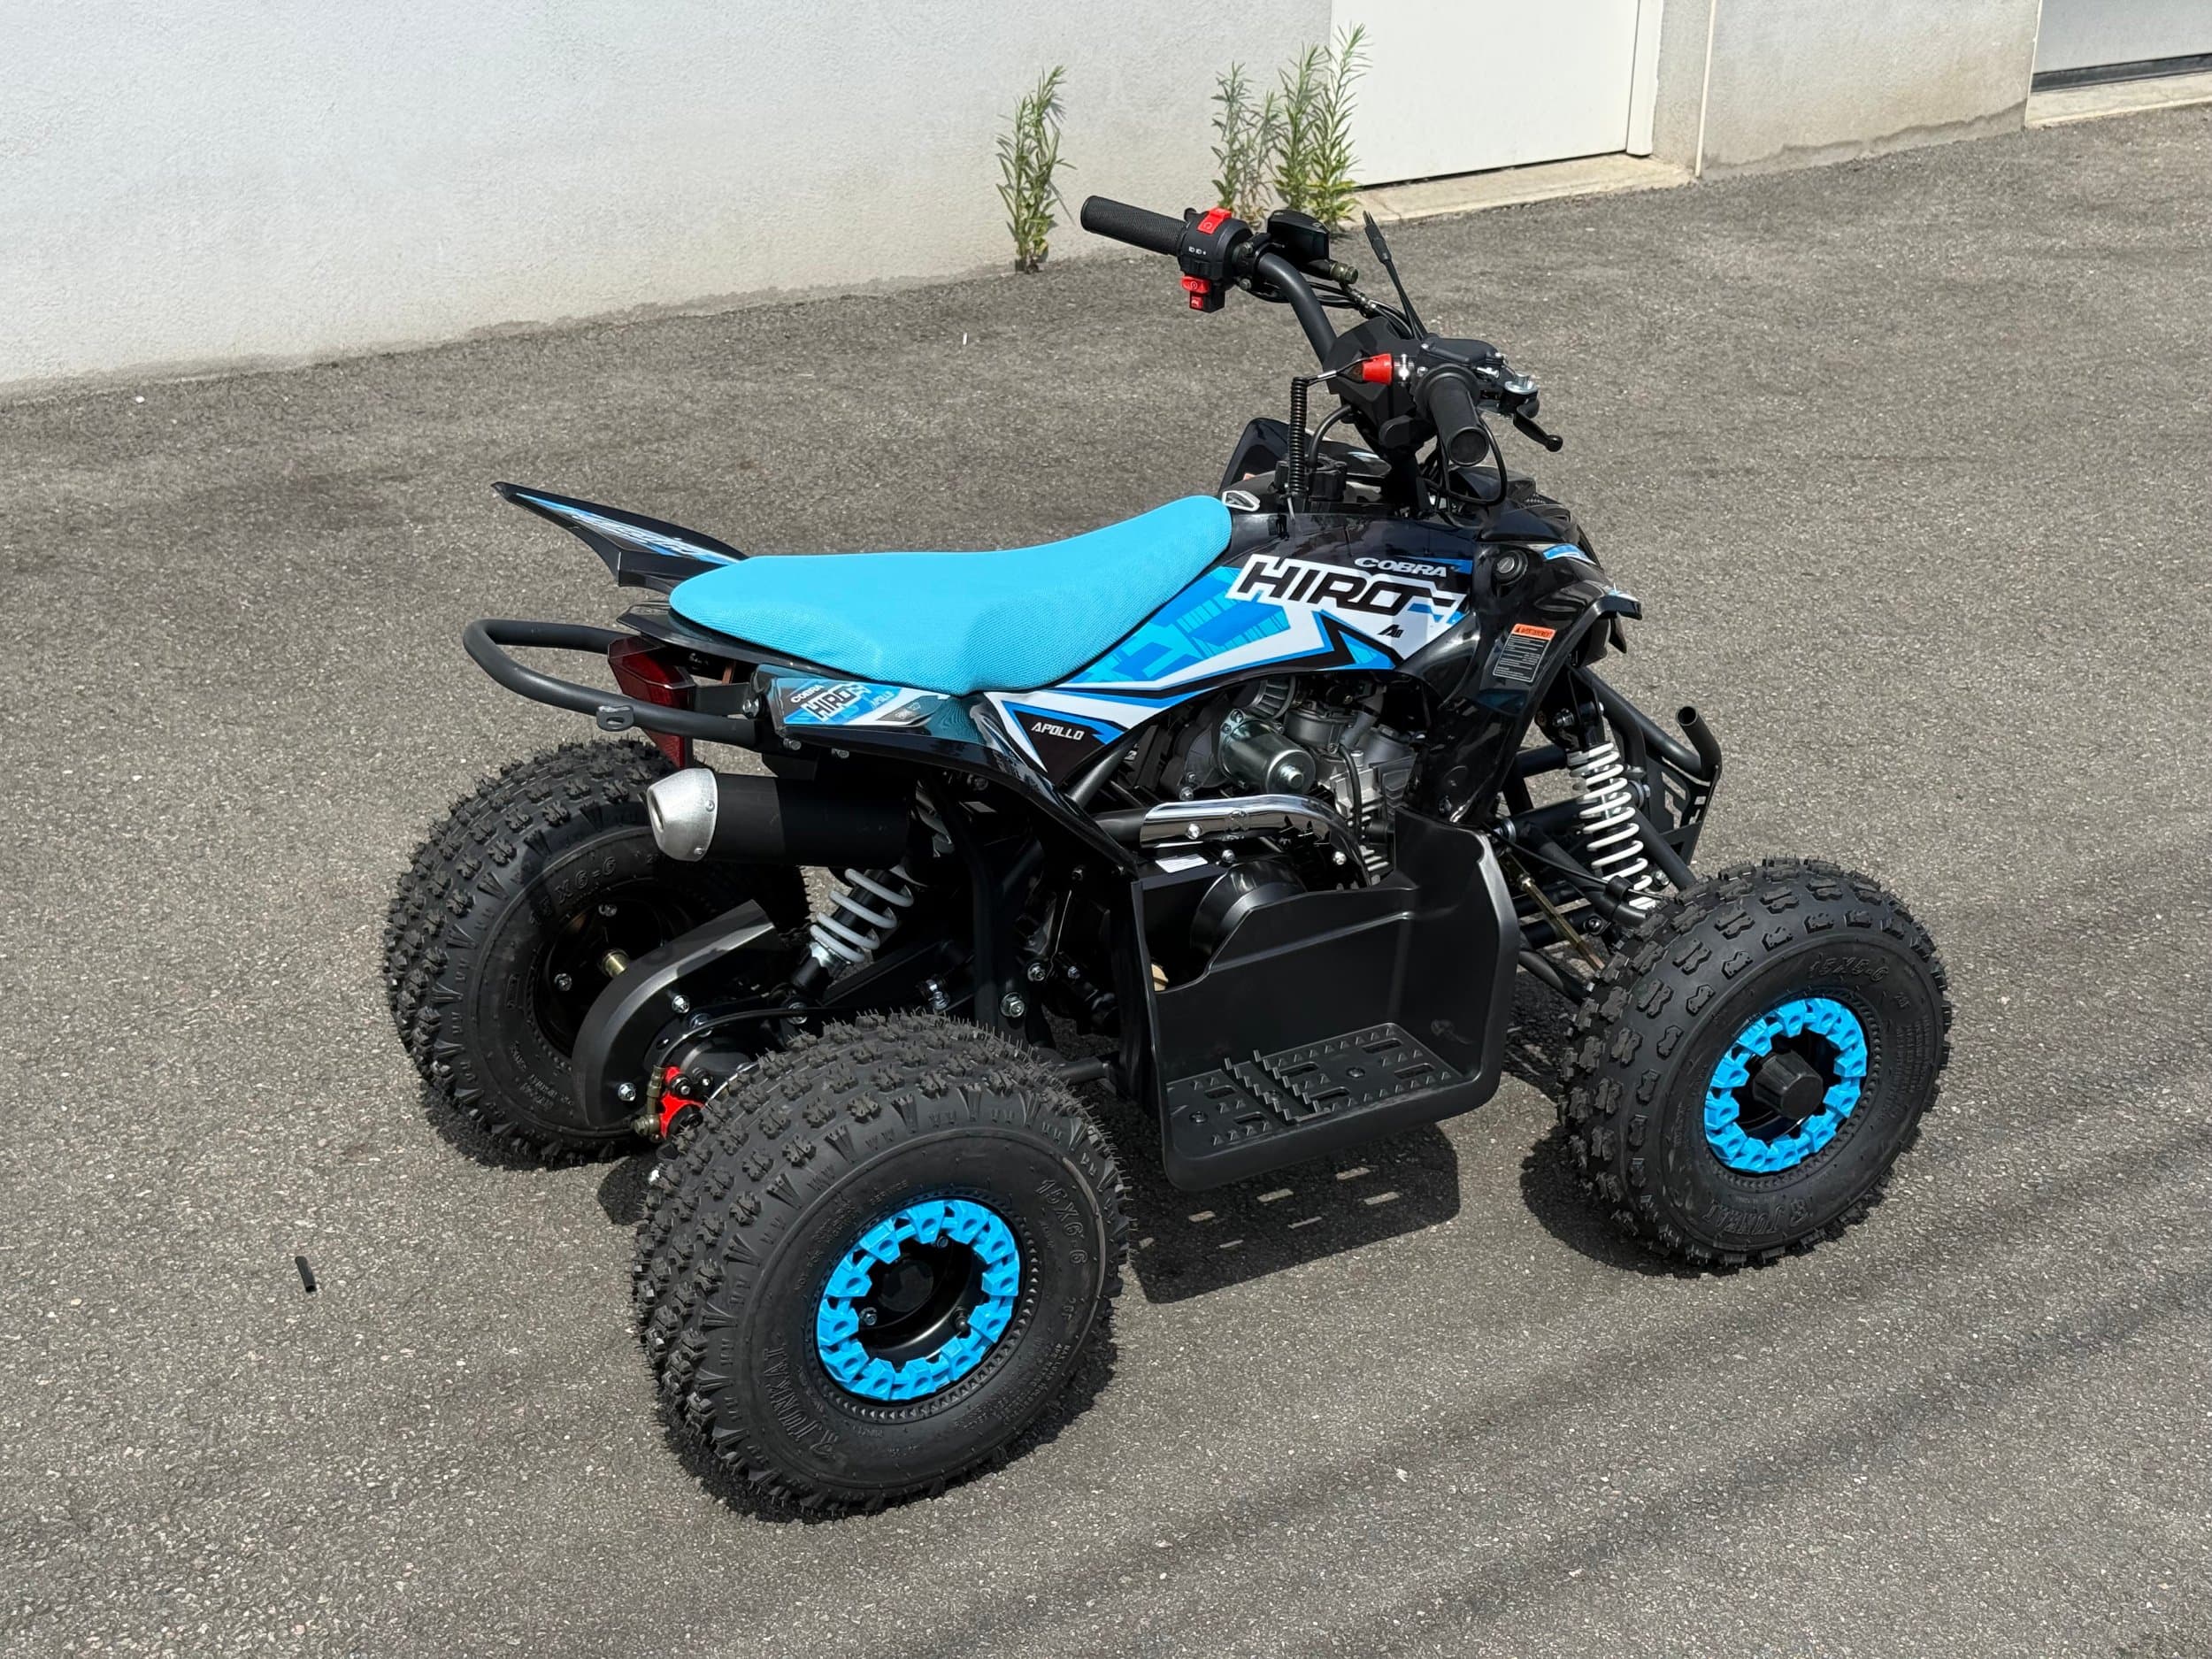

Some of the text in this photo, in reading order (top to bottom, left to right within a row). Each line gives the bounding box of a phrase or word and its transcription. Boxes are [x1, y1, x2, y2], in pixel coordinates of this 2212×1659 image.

[1354, 557, 1448, 578] COBRA
[790, 684, 825, 704] COBRA
[1030, 721, 1086, 741] APOLLO
